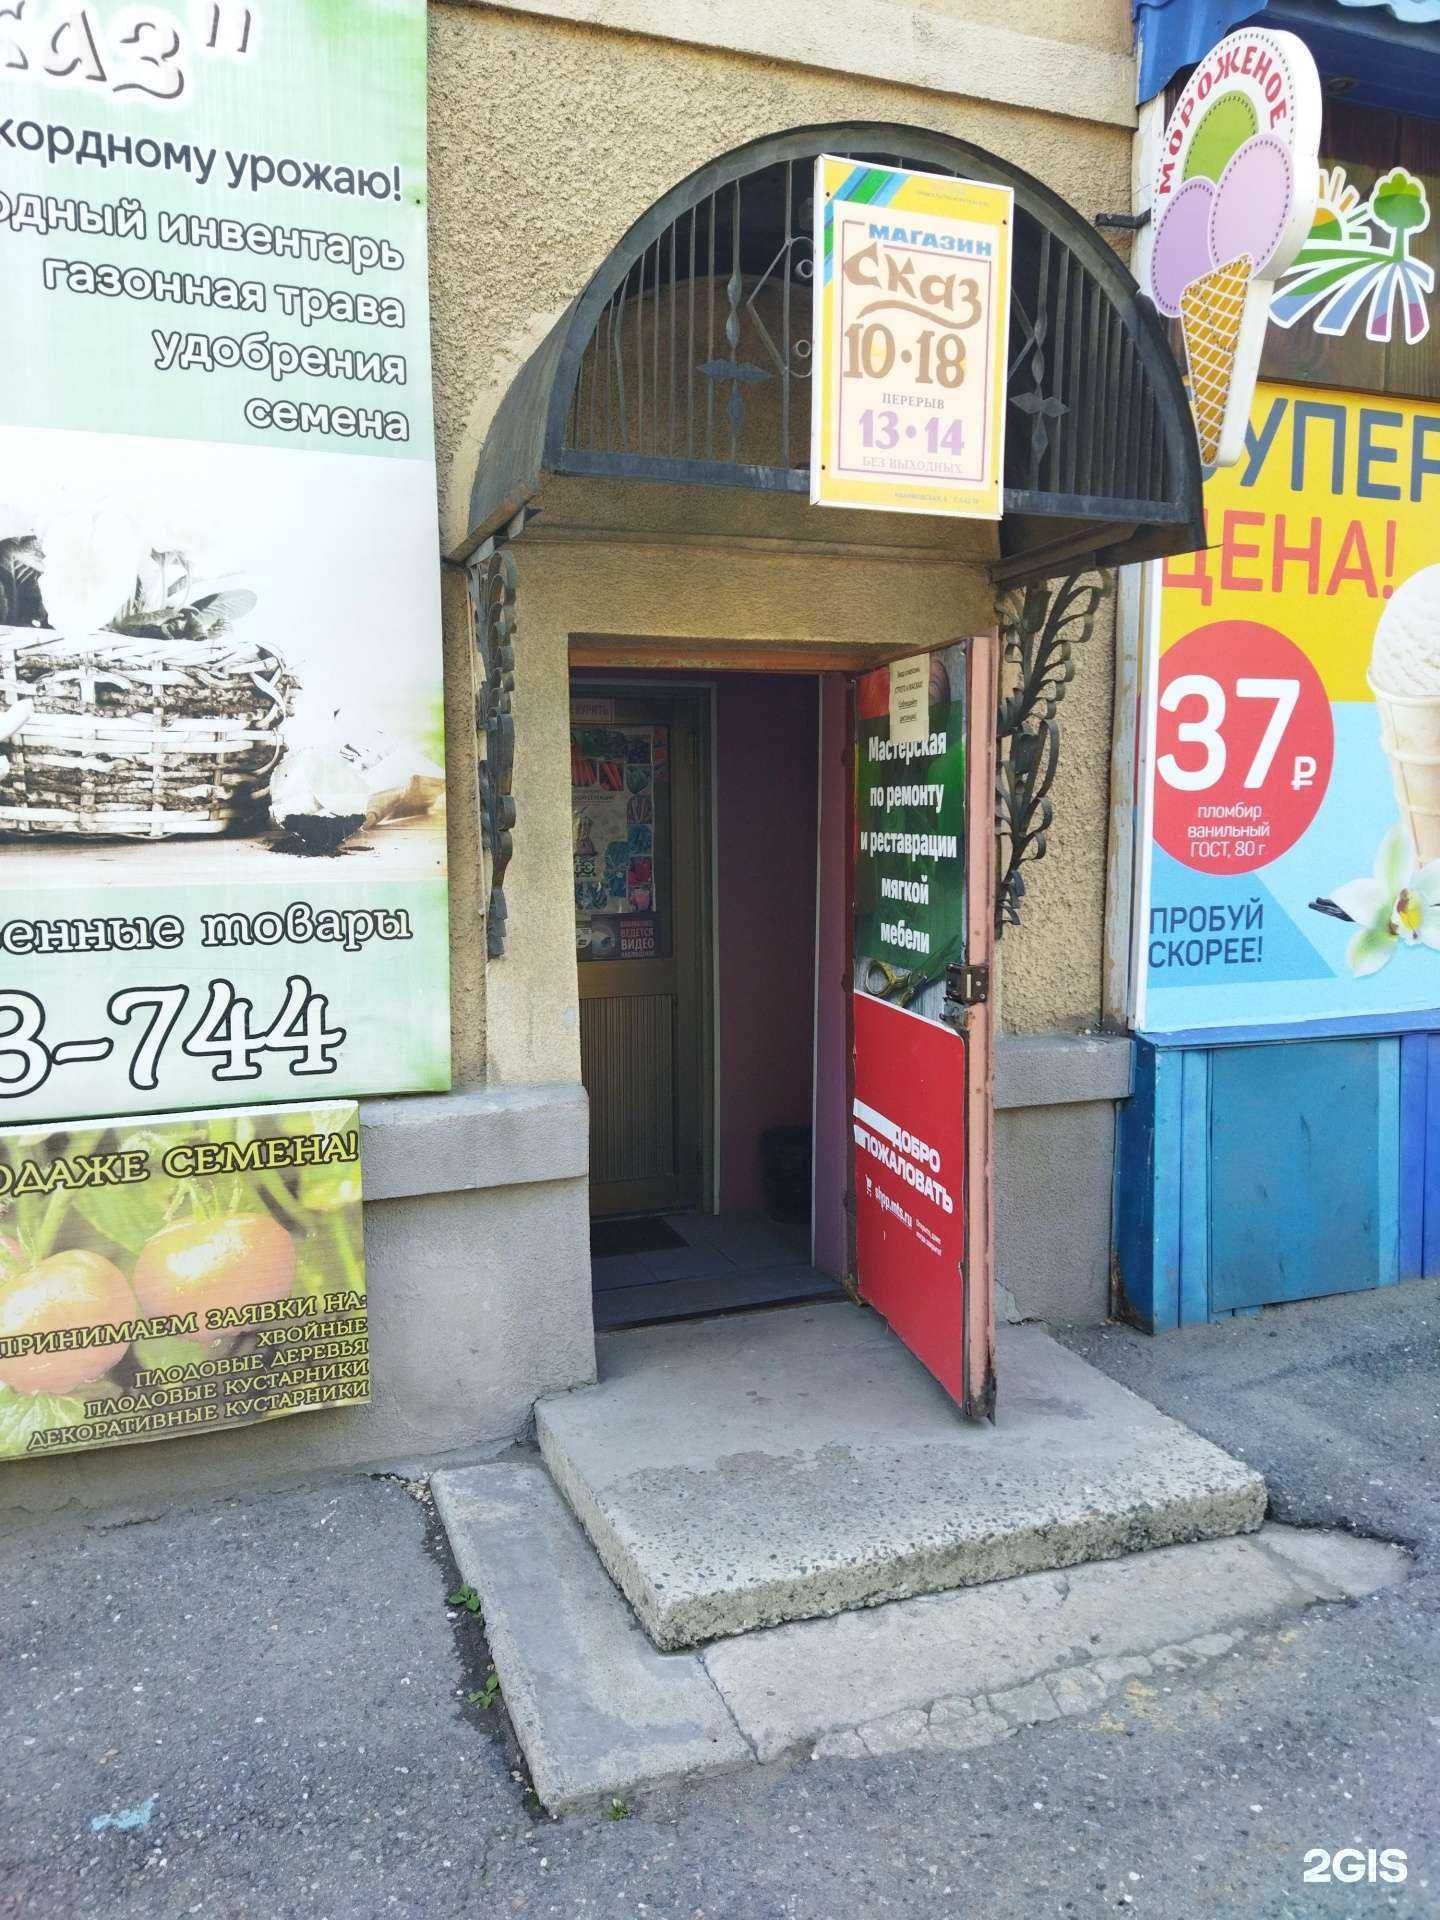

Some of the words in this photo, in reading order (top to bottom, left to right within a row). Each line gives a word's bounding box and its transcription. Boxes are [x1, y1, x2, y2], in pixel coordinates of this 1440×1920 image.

[1158, 45, 1288, 195] МОРОЖЕНОЕ
[225, 150, 402, 201] урожаю!
[158, 212, 405, 274] инвентарь
[868, 223, 992, 257] МАГАЗИН
[43, 257, 266, 312] газонная
[274, 284, 405, 328] трава
[152, 329, 407, 385] удобрения
[244, 397, 410, 441] семена
[882, 392, 945, 411] ПЕРЕРЫВ
[862, 455, 886, 470] БЕЗ
[889, 457, 963, 475] ВЫХОДНЫХ
[1202, 397, 1440, 503] УПЕР
[868, 731, 947, 767] Мастерская
[1157, 675, 1300, 792] 37
[869, 786, 885, 807] по
[886, 783, 944, 814] ремонту
[1197, 802, 1262, 819] пломбир
[860, 830, 869, 851] и
[870, 829, 957, 862] реставрации
[1187, 822, 1270, 839] ванильный
[1235, 840, 1255, 857] 80
[881, 875, 929, 906] мягкой
[200, 901, 413, 952] товары
[880, 920, 930, 954] мебели
[1149, 898, 1264, 935] ПРОБУЙ
[621, 938, 655, 951] ВИДЕО
[1148, 936, 1264, 968] СКОРЕЕ!
[163, 1130, 359, 1179] СЕМЕНА!
[892, 1125, 941, 1174] ДОБРО
[863, 1133, 954, 1215] ПОЖАЛОВАТЬ
[0, 1312, 198, 1359] ПРИНИМАЕМ
[205, 1295, 317, 1328] ЗАЯВКИ
[324, 1291, 367, 1315] НА:
[257, 1317, 367, 1349] ХВОЙНЫЕ
[135, 1354, 264, 1389] ПЛОДОВЫЕ
[269, 1339, 368, 1369] ДЕРЕВЬЯ
[84, 1383, 218, 1419] ПЛОДОВЫЕ
[224, 1359, 369, 1397] КУСТАРНИКИ
[27, 1405, 219, 1451] ДЕКОРАТИВНЫЕ
[225, 1380, 370, 1418] КУСТАРНИКИ
